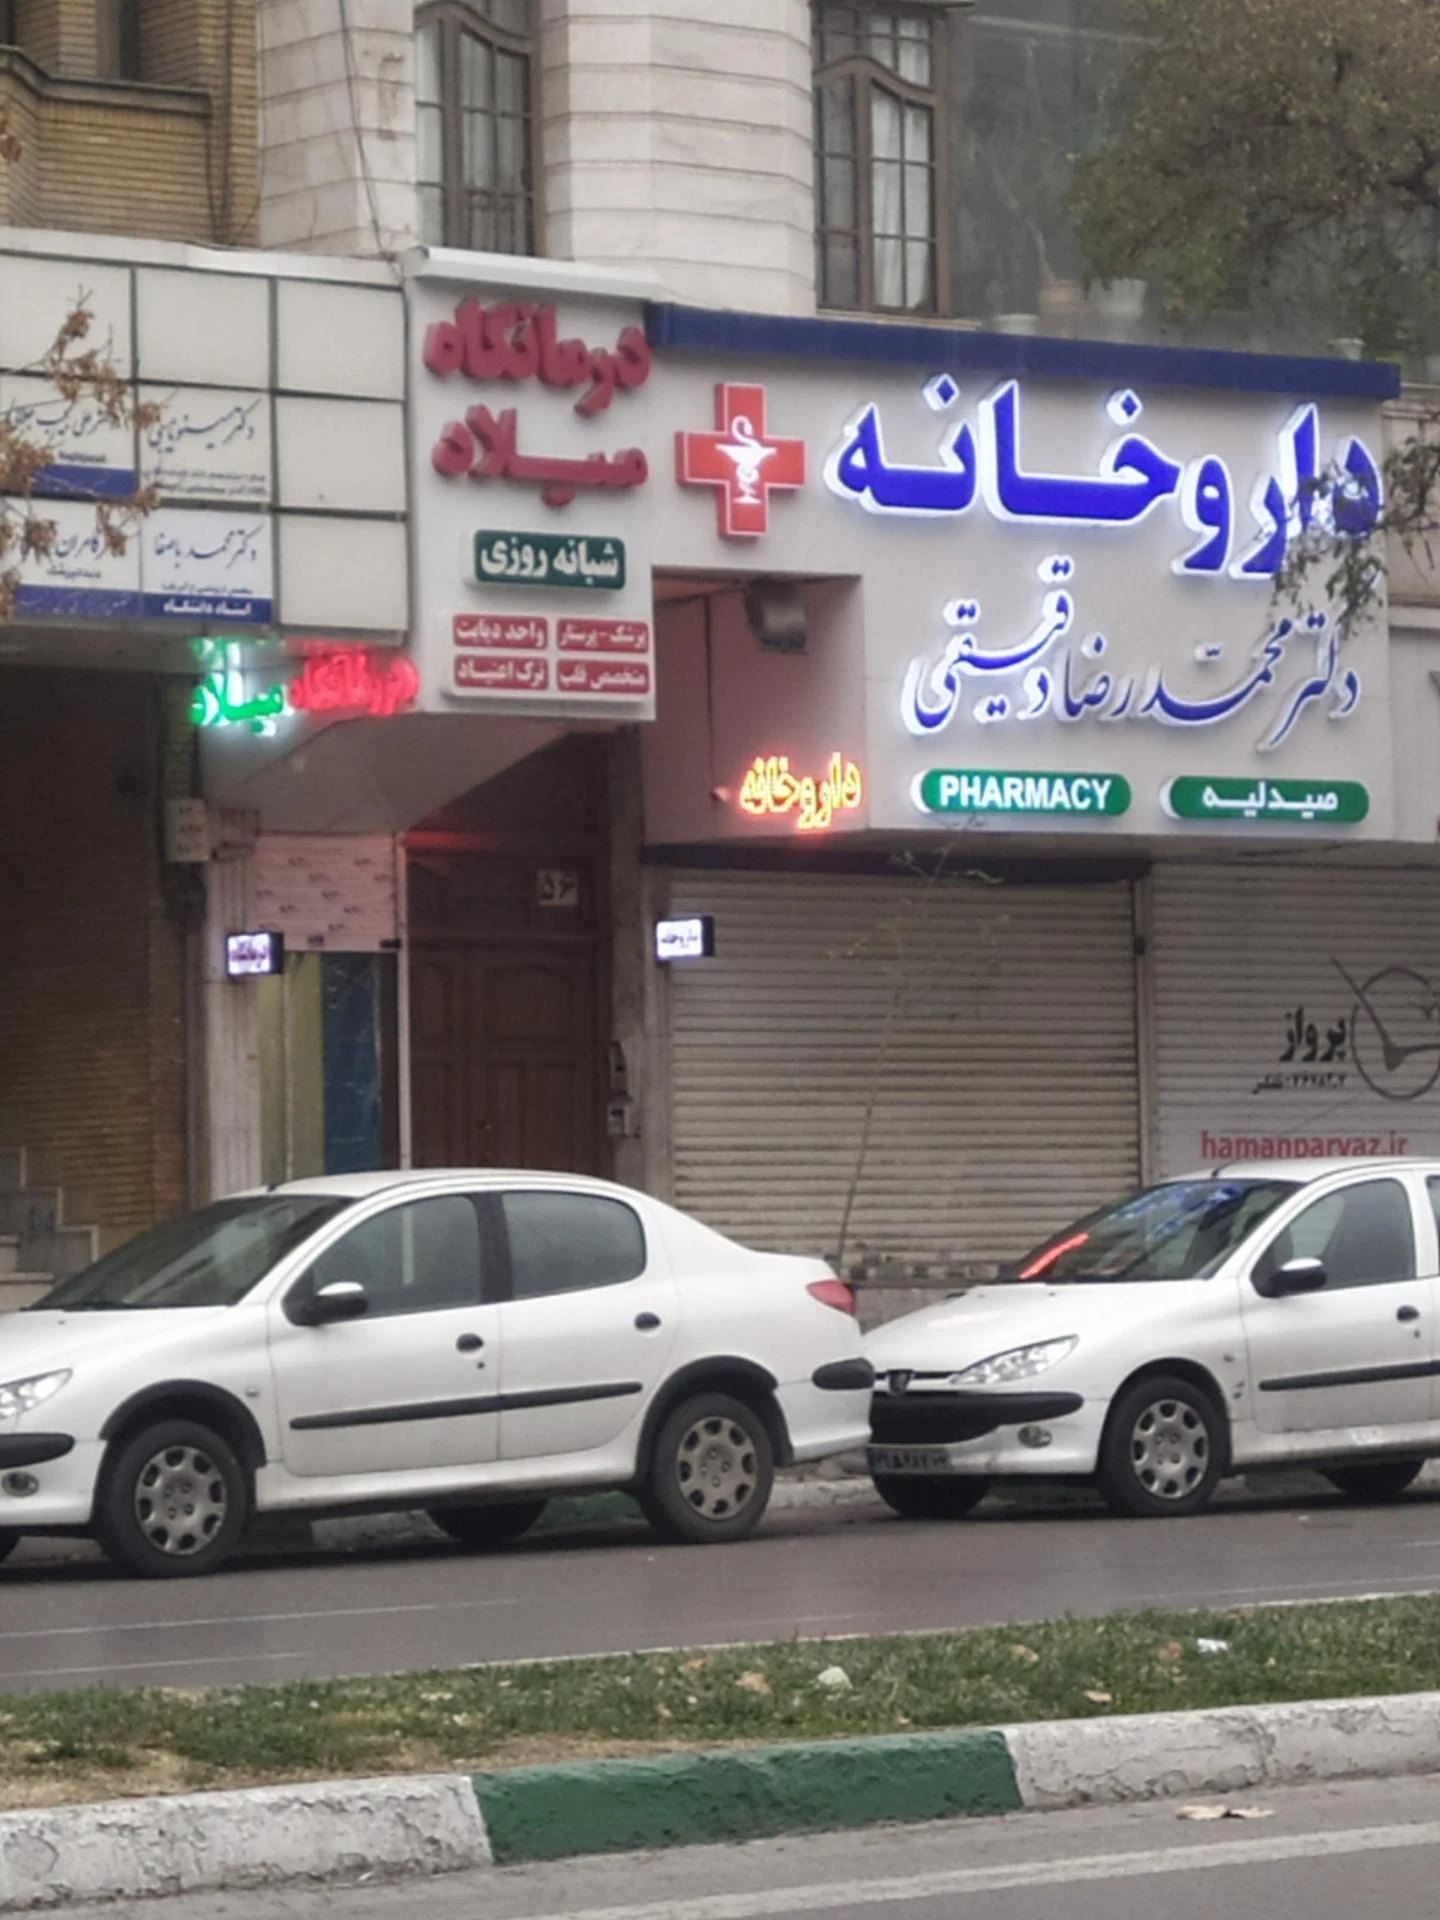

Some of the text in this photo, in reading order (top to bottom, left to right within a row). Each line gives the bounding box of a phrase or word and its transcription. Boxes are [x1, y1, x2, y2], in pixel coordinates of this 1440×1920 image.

[423, 297, 653, 420] درمانگاه
[432, 403, 649, 509] میلاد
[824, 373, 1384, 580] داروخانه
[480, 536, 619, 586] شبانه روزی
[455, 618, 548, 648] واحد دیابت
[902, 554, 1074, 736] دقیقی
[1255, 567, 1385, 751] دکتر
[457, 658, 546, 688] ترک اعتیاد
[739, 751, 862, 829] داروخانه
[938, 774, 1113, 811] PHARMACY
[1278, 1005, 1347, 1062] پرواز
[1200, 1129, 1409, 1159] hamanparvaz.ir
